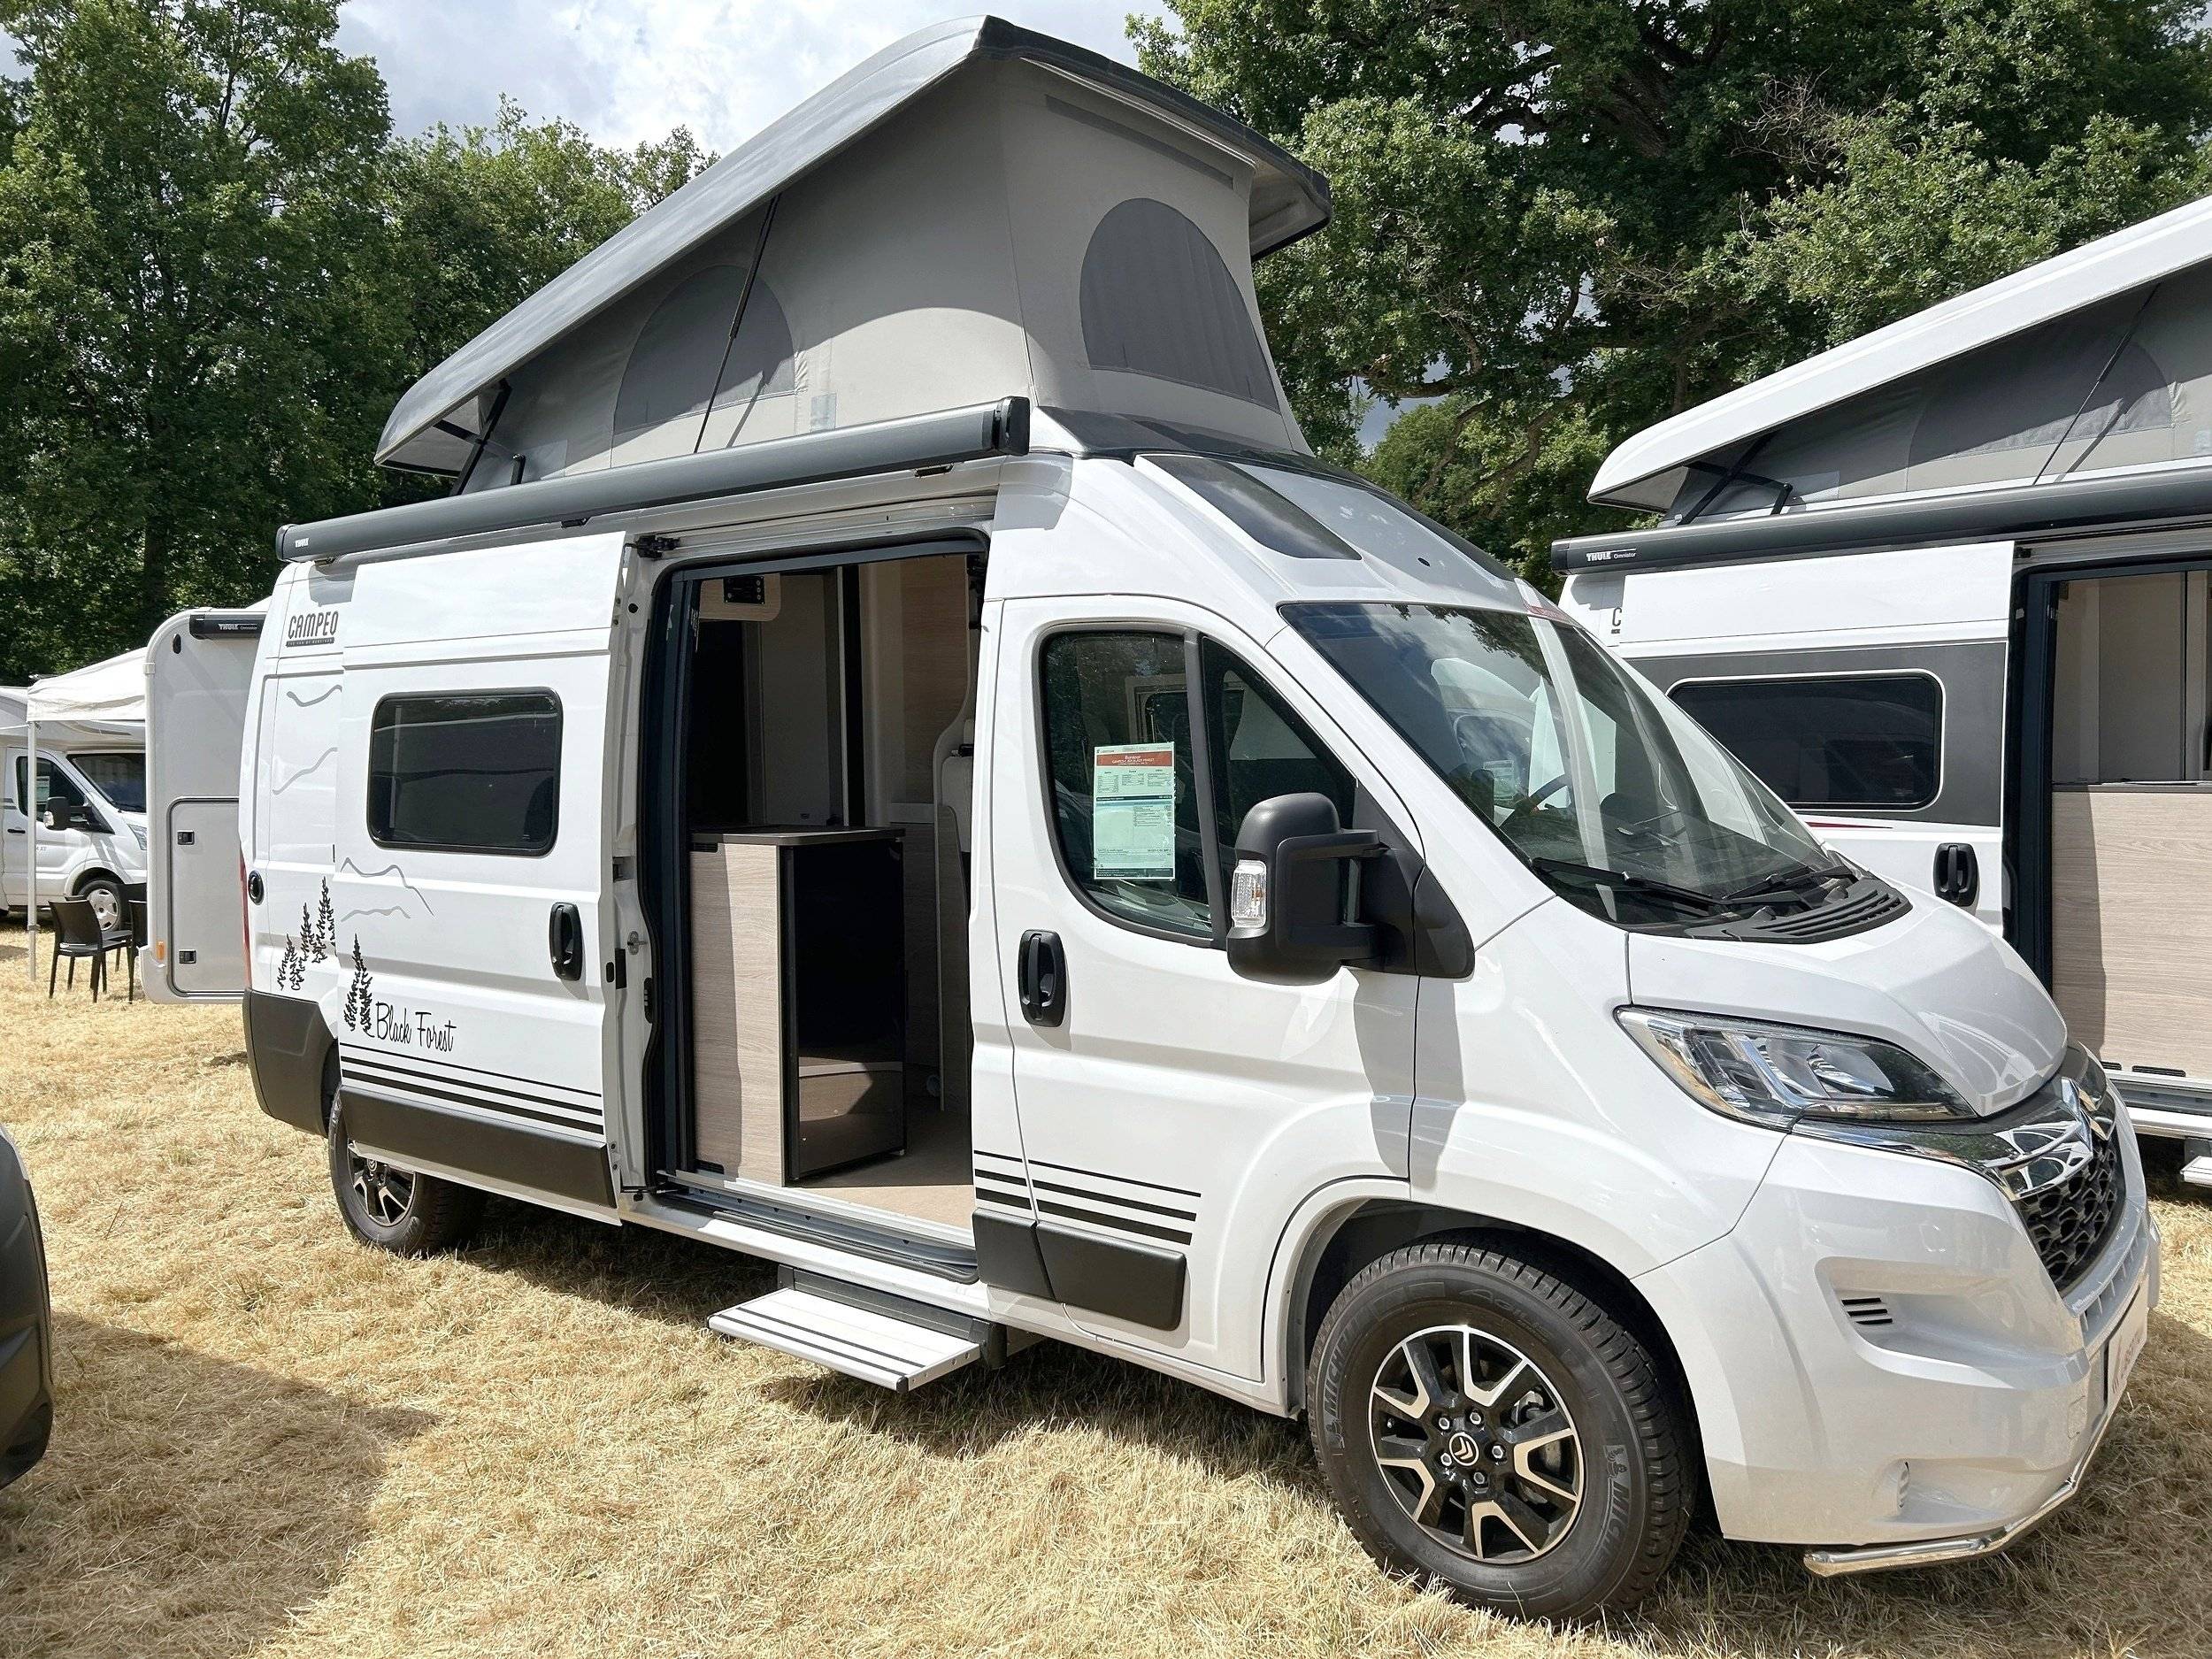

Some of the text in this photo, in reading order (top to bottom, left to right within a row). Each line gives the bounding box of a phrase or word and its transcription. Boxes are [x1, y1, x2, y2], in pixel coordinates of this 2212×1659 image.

[1586, 550, 1611, 562] THULE
[288, 611, 340, 639] CAMPEO
[375, 1001, 457, 1052] Black Forest
